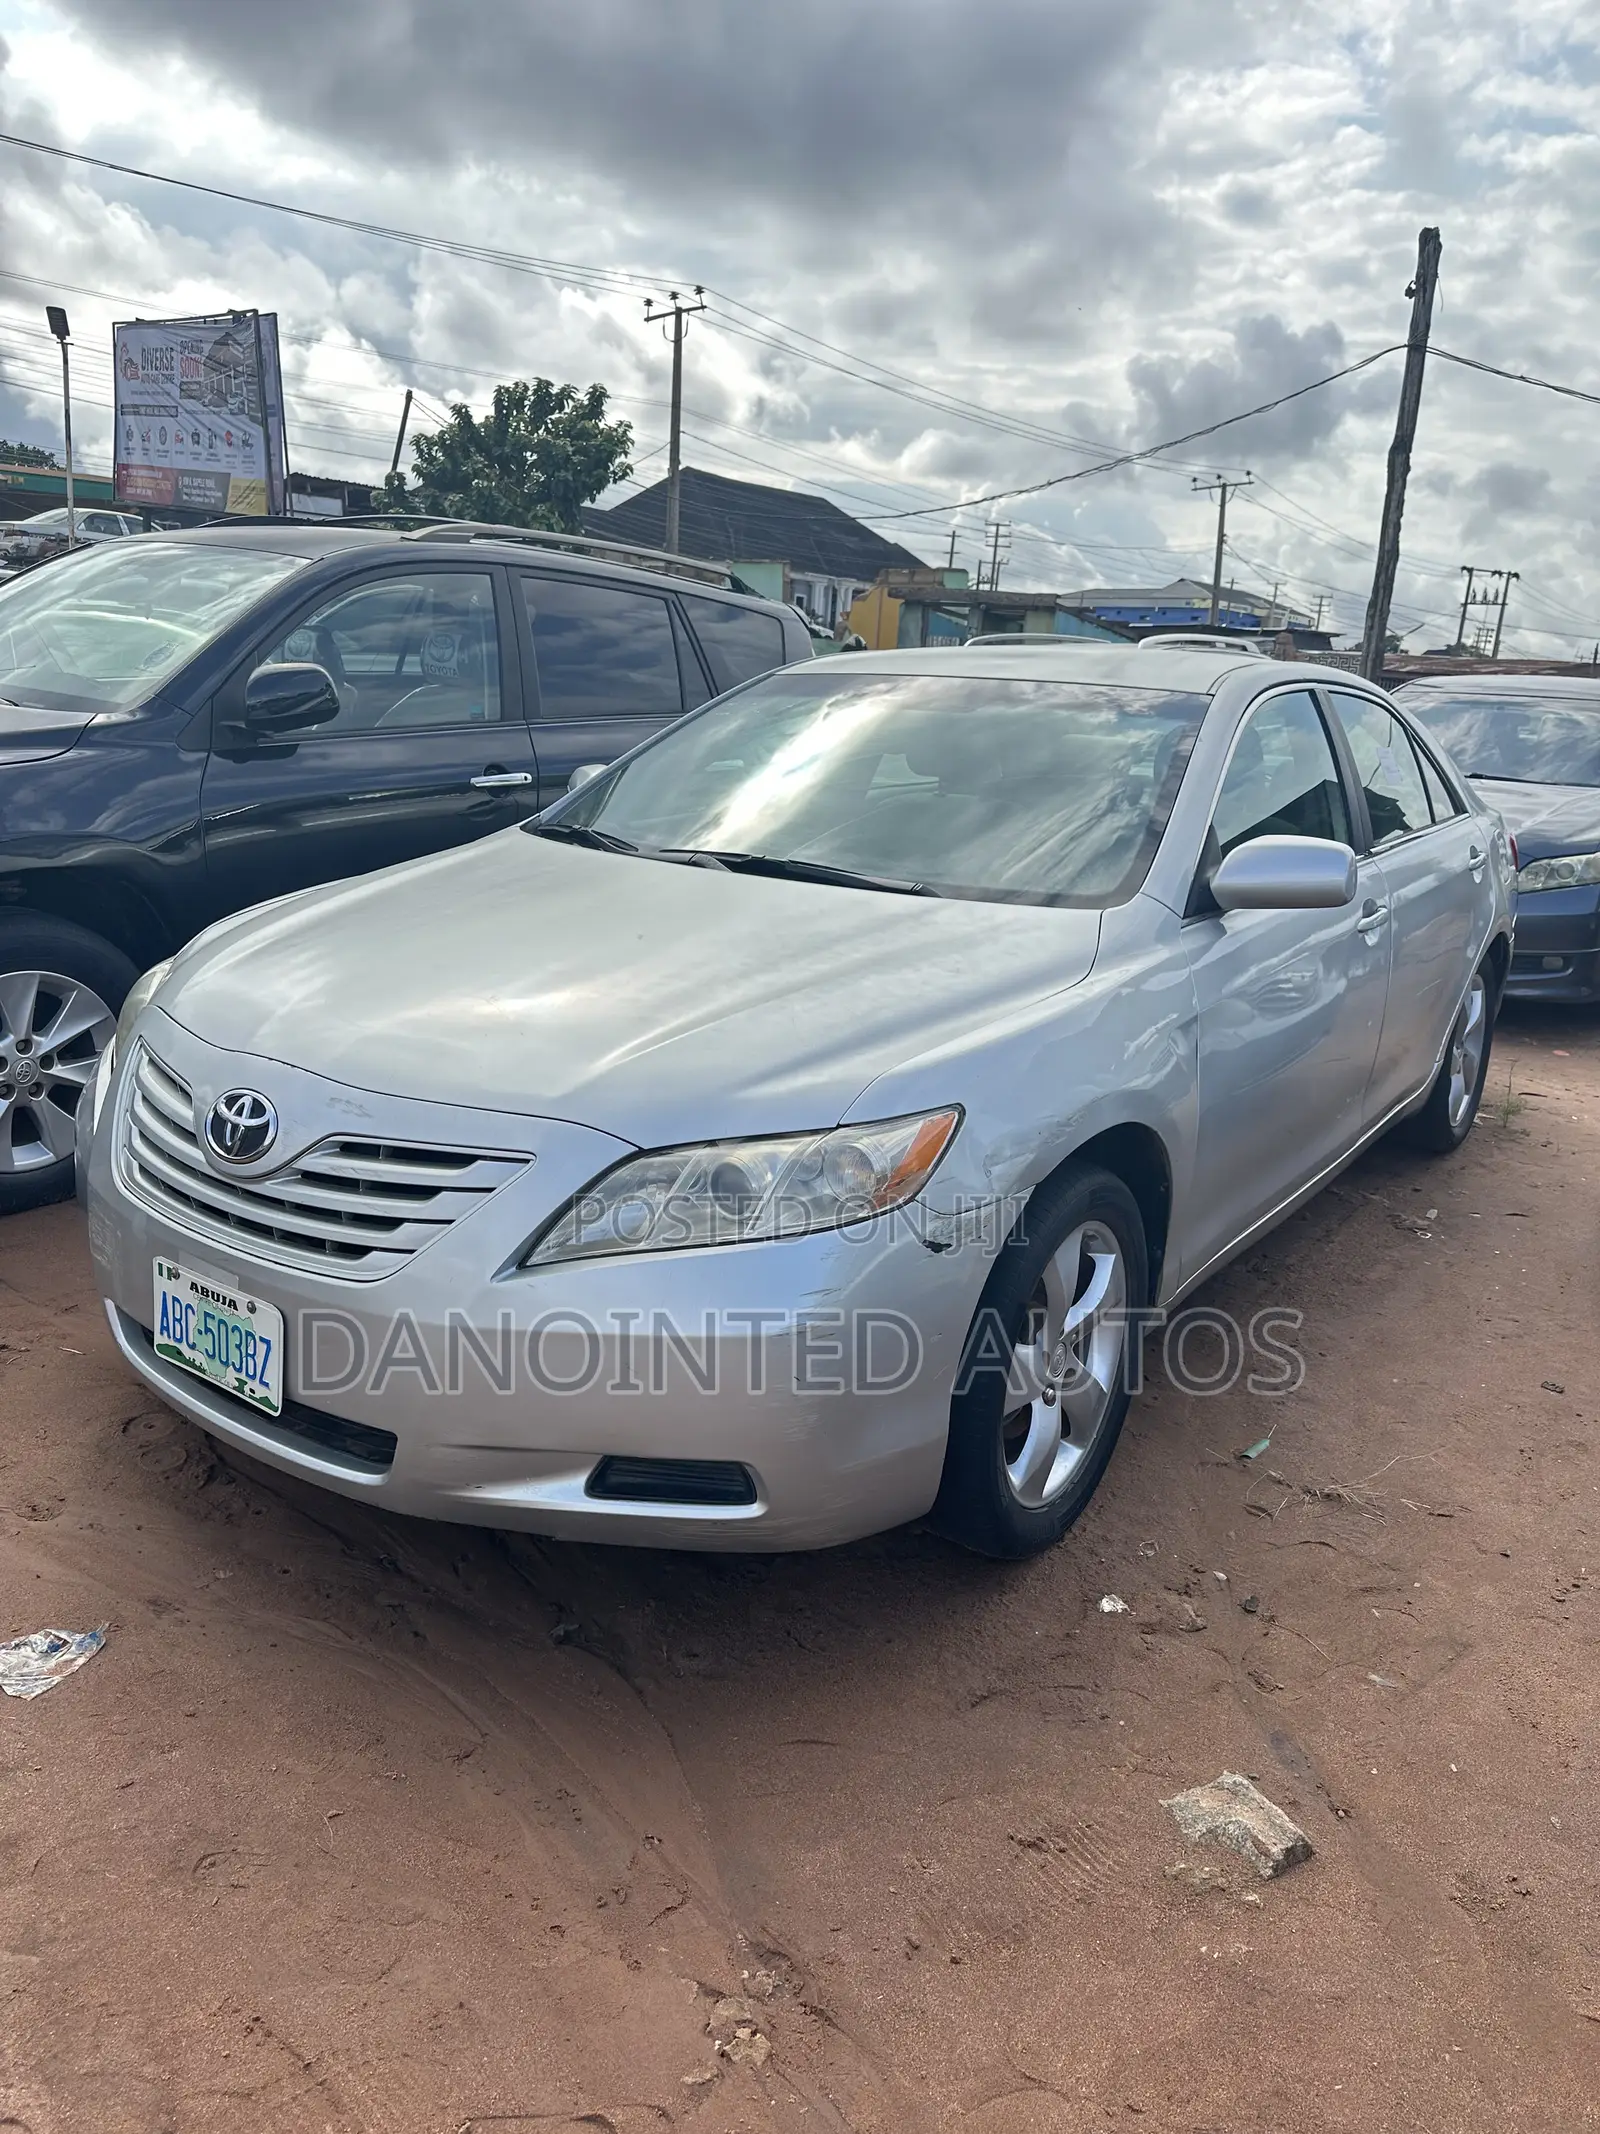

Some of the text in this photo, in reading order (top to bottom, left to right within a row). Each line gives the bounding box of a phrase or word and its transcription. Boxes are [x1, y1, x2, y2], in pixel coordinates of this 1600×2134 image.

[141, 347, 174, 371] DIVERSE
[424, 663, 459, 676] TOYOTA
[189, 1281, 239, 1312] ABUJA
